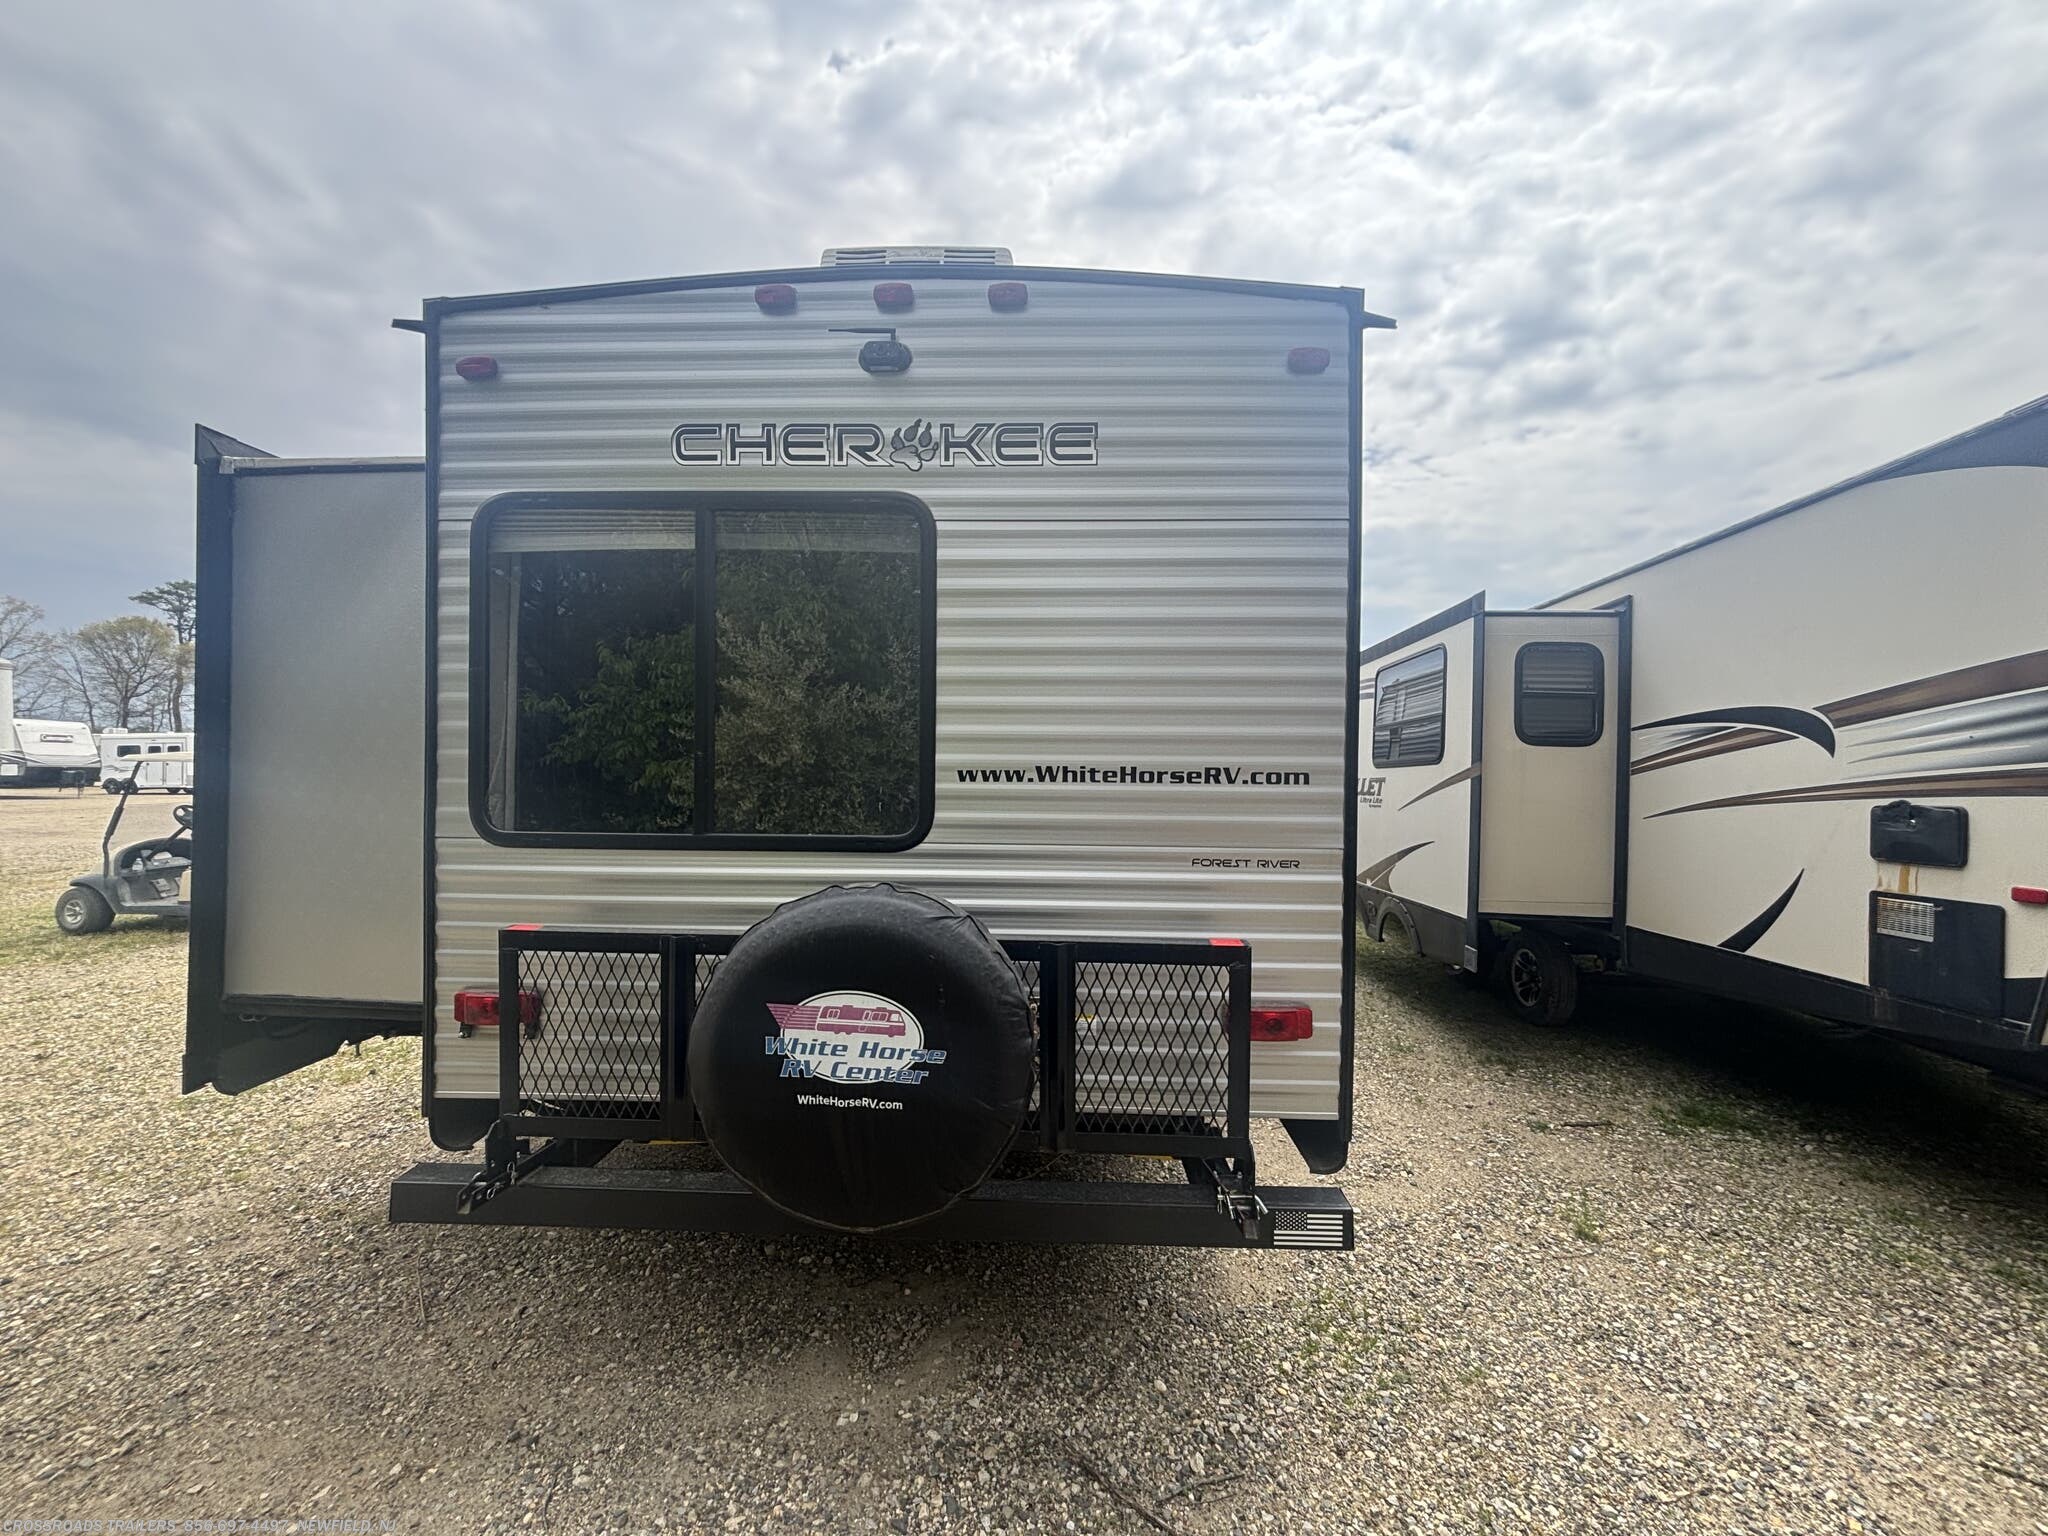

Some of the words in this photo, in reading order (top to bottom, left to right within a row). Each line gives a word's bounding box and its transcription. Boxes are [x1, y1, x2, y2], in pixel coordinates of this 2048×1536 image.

[671, 419, 1098, 471] CHERKEE
[957, 765, 1310, 786] www.WhiteHorseRV.com
[1358, 777, 1386, 796] LET
[1191, 858, 1251, 868] FOREST
[1257, 859, 1301, 869] RIVER
[764, 1036, 849, 1057] White
[858, 1041, 947, 1065] Horse
[779, 1058, 822, 1078] RV
[830, 1062, 929, 1085] Center
[797, 1094, 903, 1110] WhiteHorseRV.com
